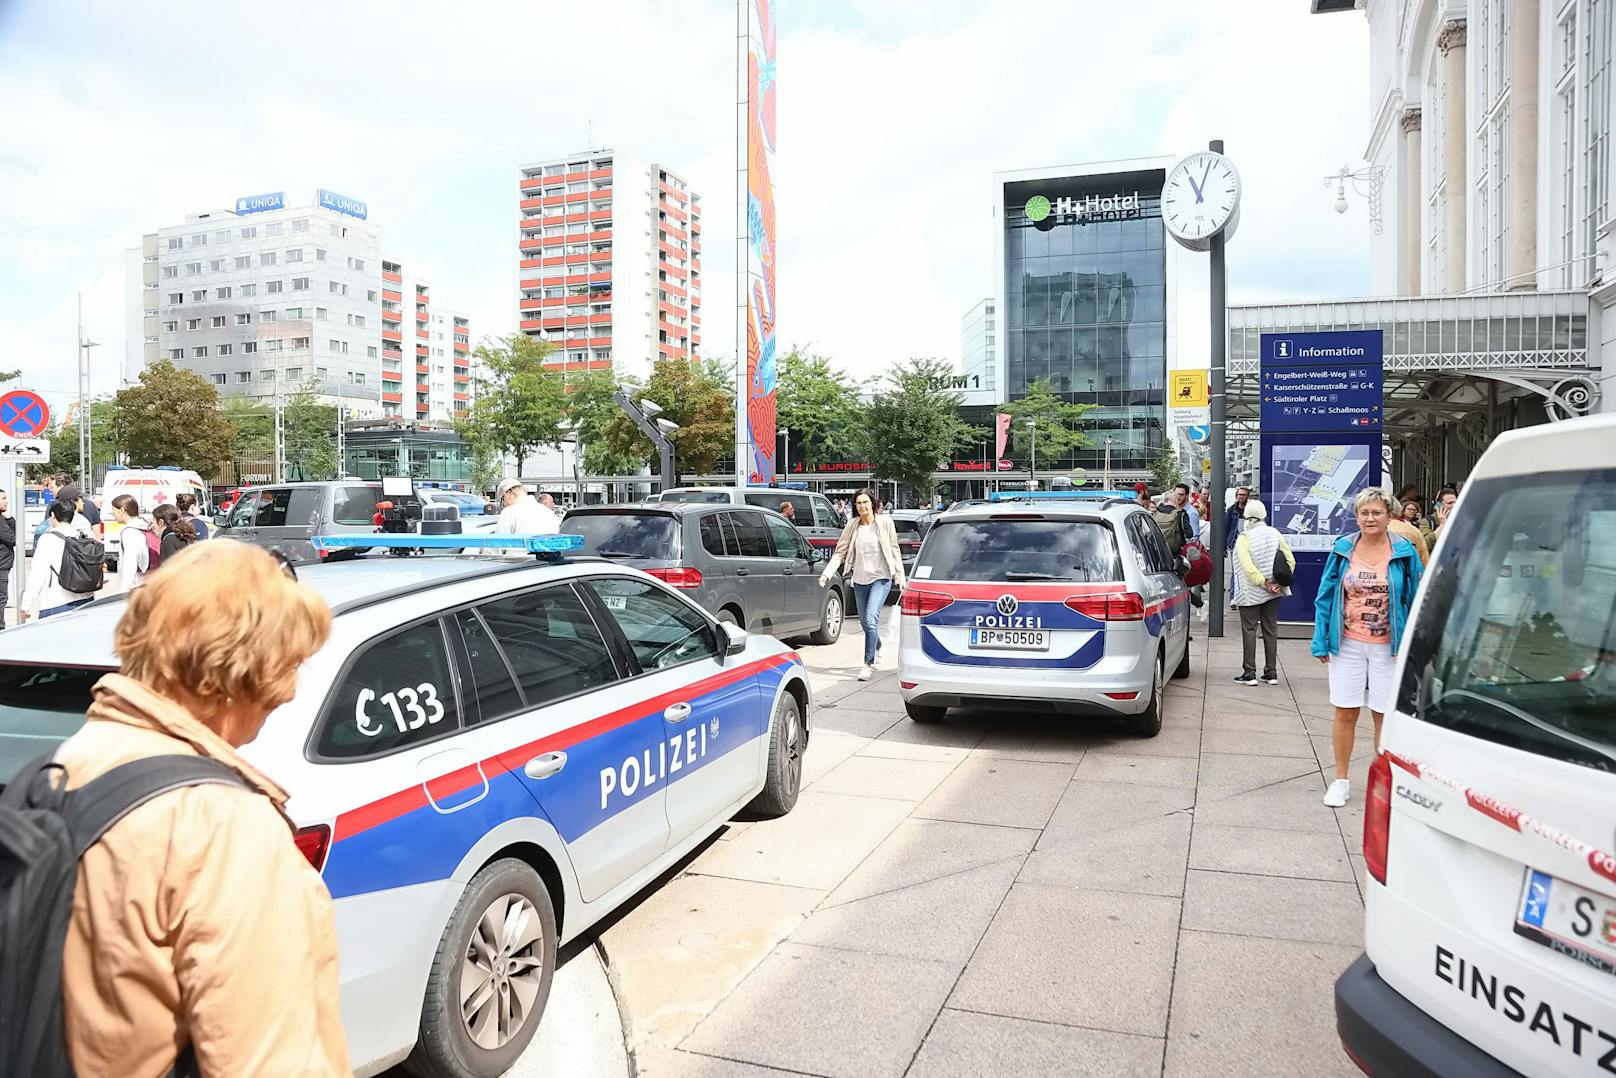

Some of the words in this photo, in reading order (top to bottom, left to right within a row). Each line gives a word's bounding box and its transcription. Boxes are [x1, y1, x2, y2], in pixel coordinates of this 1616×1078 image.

[251, 196, 280, 208] UNIQA
[337, 200, 367, 215] UNIQA
[1299, 346, 1364, 357] Information
[928, 375, 968, 389] RUM
[972, 375, 980, 388] 1
[1273, 371, 1347, 380] Engelbert-Weiß-Weg
[1273, 383, 1348, 391] Kaiserschützenstraße
[1328, 406, 1369, 414] Schallmoos
[819, 463, 877, 471] EUROSP
[975, 616, 1041, 629] POLIZEI
[981, 631, 996, 643] BP
[1005, 632, 1043, 645] 50509
[380, 683, 445, 733] 133
[600, 723, 706, 810] POLIZEI
[1396, 785, 1443, 812] CADDY
[1593, 852, 1616, 874] PO
[1571, 896, 1596, 937] S
[1435, 944, 1616, 1075] EINSATZ
